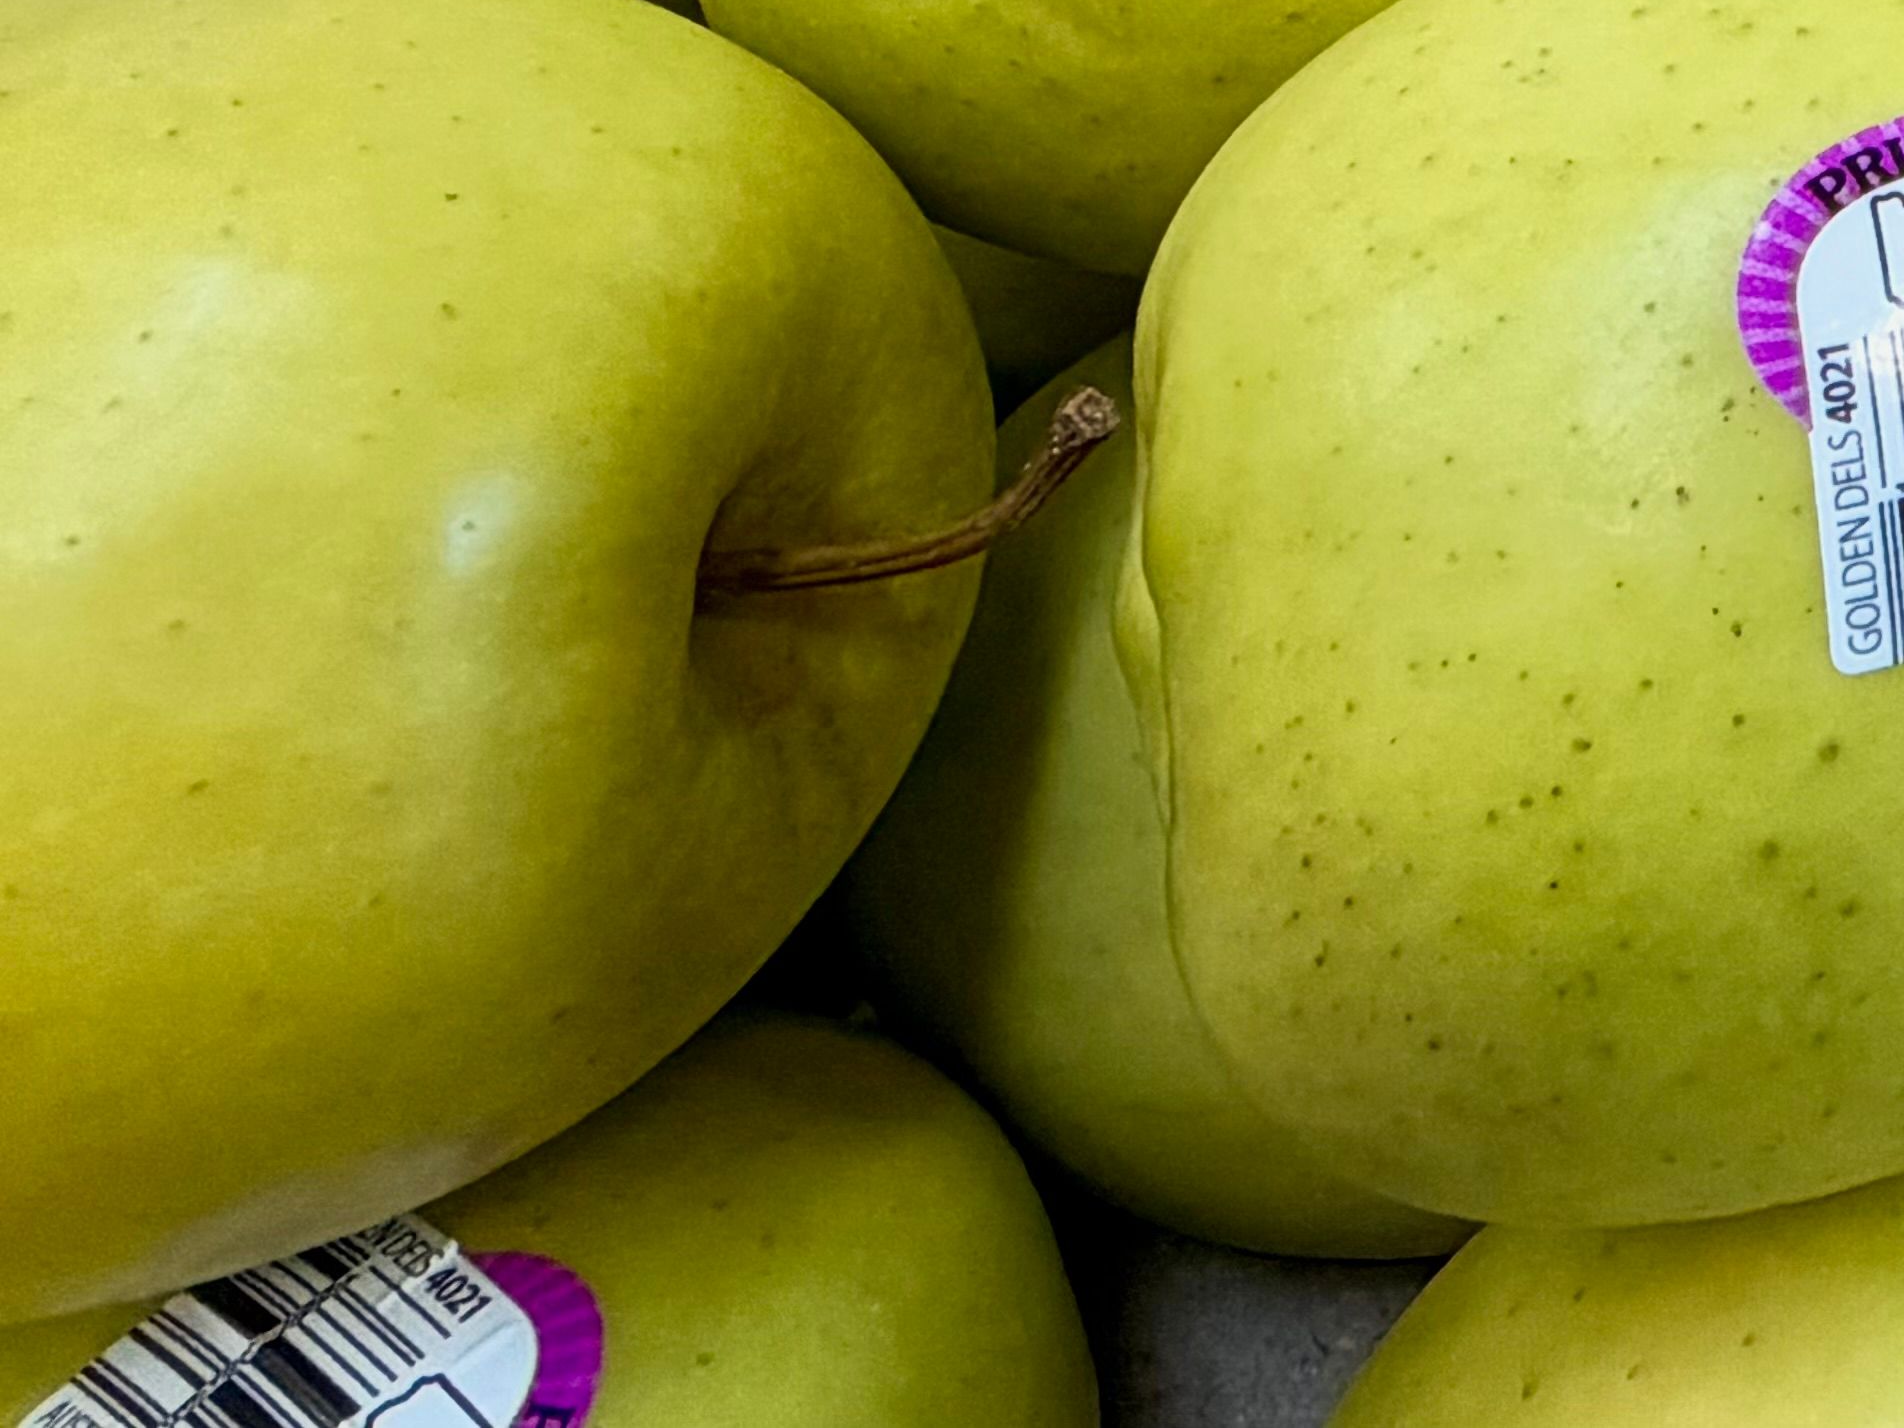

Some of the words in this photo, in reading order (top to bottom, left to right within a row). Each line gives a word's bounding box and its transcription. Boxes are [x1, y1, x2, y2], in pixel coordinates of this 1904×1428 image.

[1816, 343, 1856, 425] 4021
[1826, 430, 1869, 506] DELS
[1834, 512, 1884, 656] GOLDEN
[424, 1266, 492, 1324] 4021
